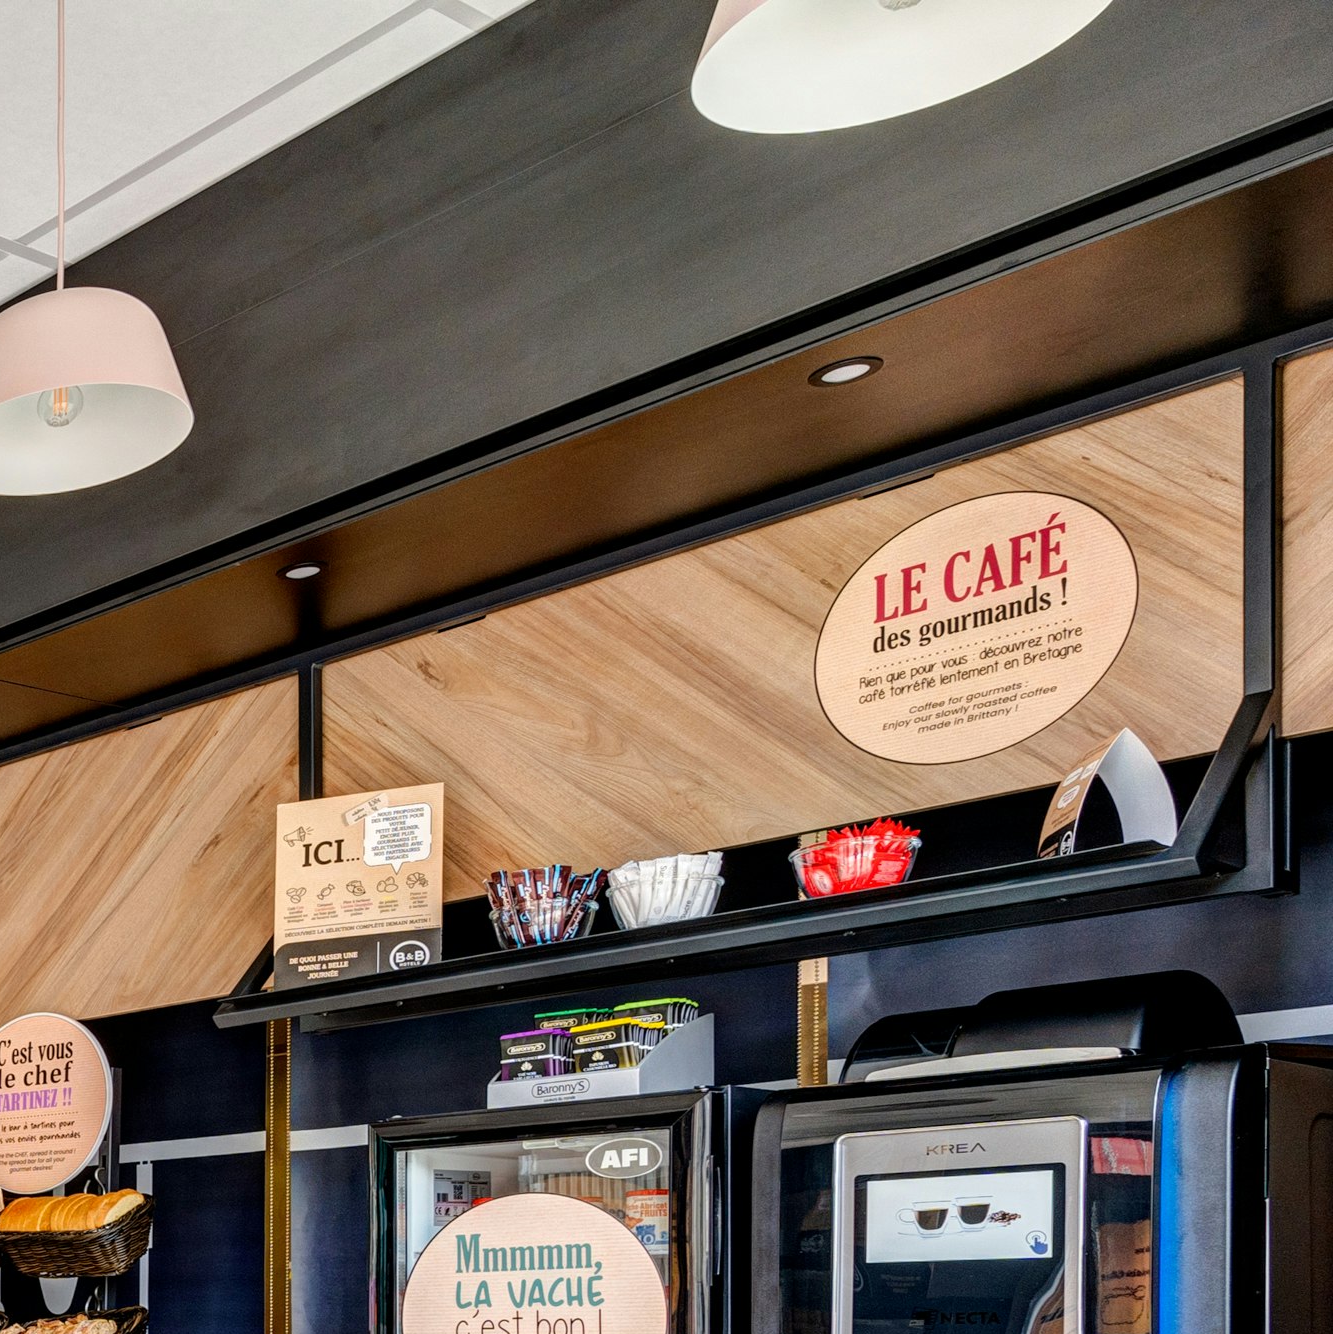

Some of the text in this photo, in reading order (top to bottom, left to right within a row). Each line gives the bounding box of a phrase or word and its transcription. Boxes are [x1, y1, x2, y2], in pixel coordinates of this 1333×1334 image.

[873, 512, 1068, 624] LE CAFÉ
[873, 577, 1068, 654] des gourmands !
[859, 625, 1083, 690] Rien que pour vous découvrez notre
[859, 643, 1083, 705] café torréfié lentement en Bretagne
[882, 684, 1058, 731] Enjoy our slowly roasted coffee
[909, 681, 1022, 714] Coffee for gourmets
[917, 706, 1012, 734] made in Brittany
[298, 964, 321, 972] BONNE
[328, 961, 349, 970] BELLE
[299, 955, 316, 964] QUOI
[317, 953, 342, 962] PASSER
[343, 951, 358, 959] UNE
[395, 950, 425, 963] B&B
[307, 970, 339, 979] JOURNÉE
[38, 1041, 73, 1061] vous
[23, 1061, 73, 1086] chef
[18, 1135, 36, 1143] envies
[39, 1131, 80, 1143] gourmandes
[23, 1122, 27, 1130] à
[59, 1121, 75, 1129] pour
[601, 1147, 648, 1169] AFI
[455, 1234, 602, 1274] Mmmmm,
[456, 1275, 604, 1308] LA VACHE
[940, 1312, 1000, 1325] NECTA
